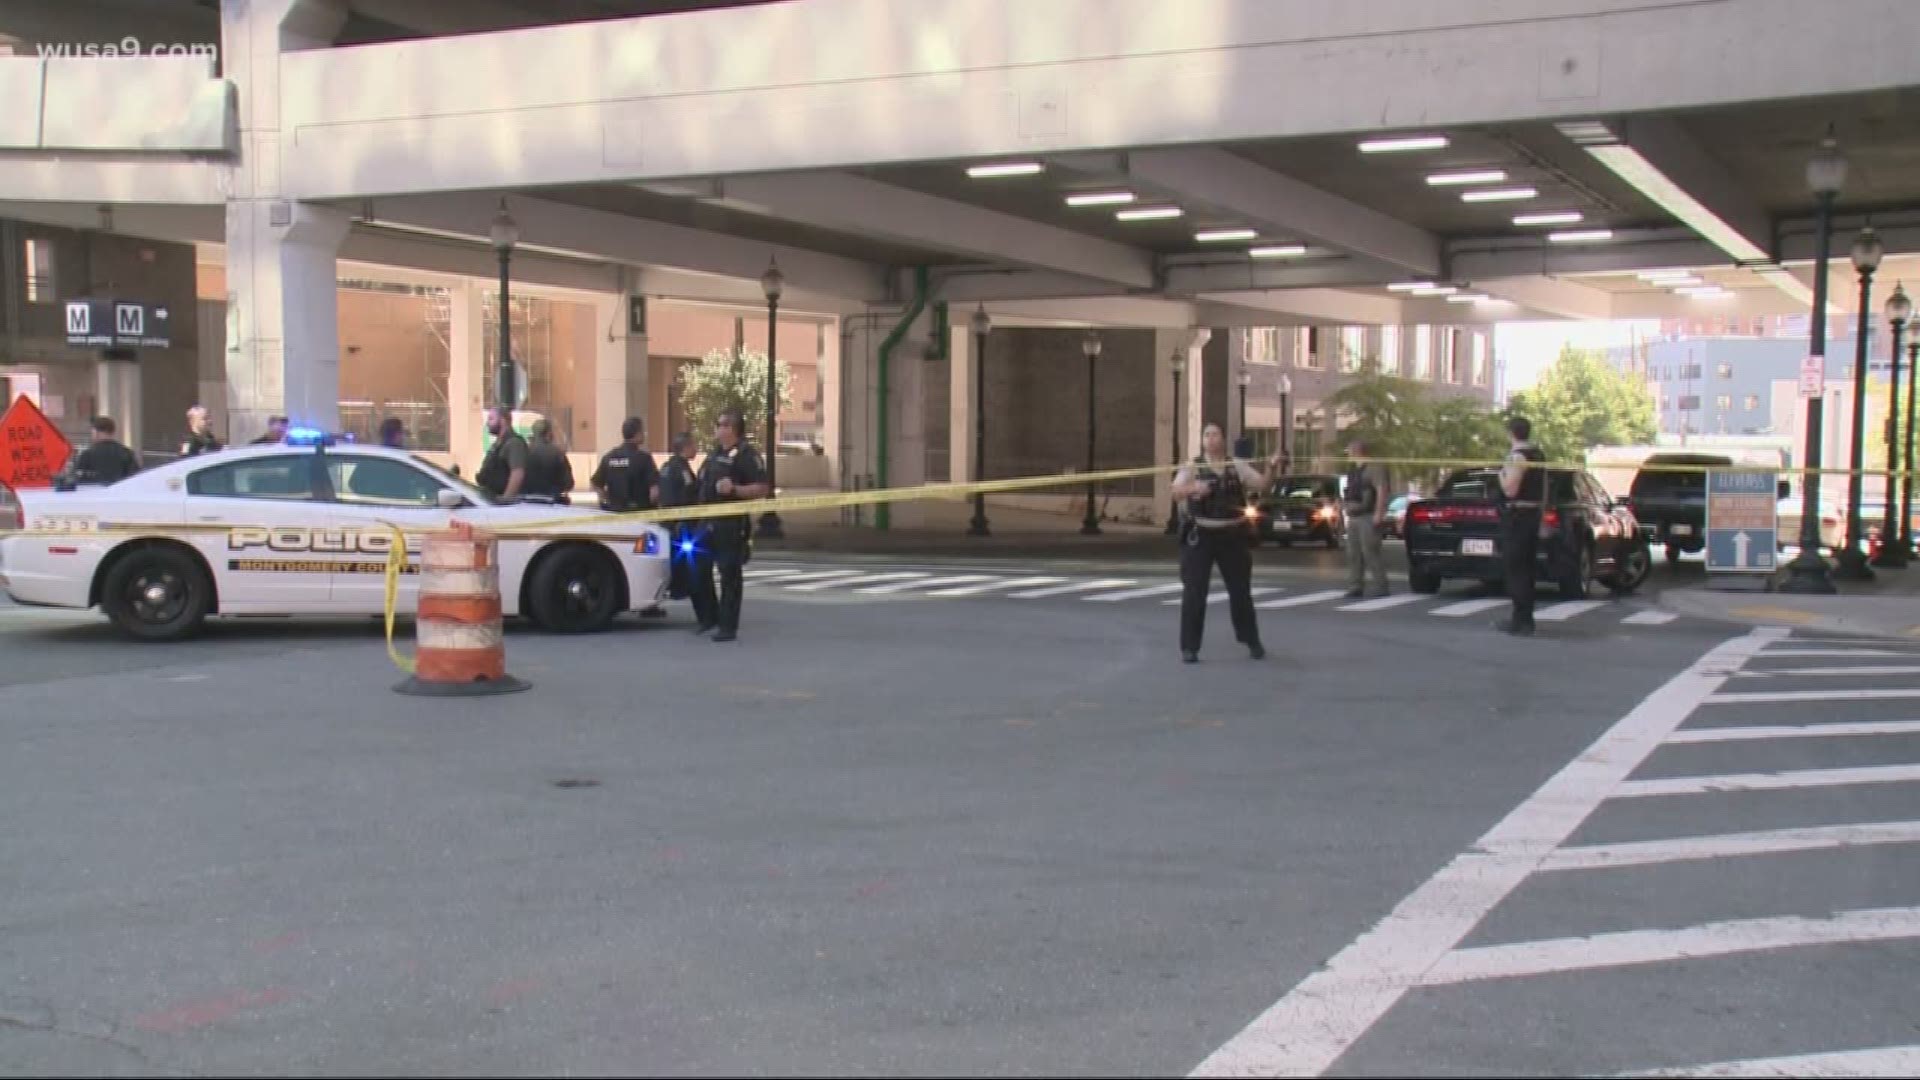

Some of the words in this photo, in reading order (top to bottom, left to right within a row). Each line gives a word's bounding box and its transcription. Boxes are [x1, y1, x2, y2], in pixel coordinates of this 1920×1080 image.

[8, 426, 43, 443] ROAD
[12, 446, 45, 463] WORK
[11, 465, 49, 484] AHEAD
[228, 527, 421, 554] POLICE
[238, 561, 351, 572] MONTGOMERY
[355, 563, 421, 574] COUTY
